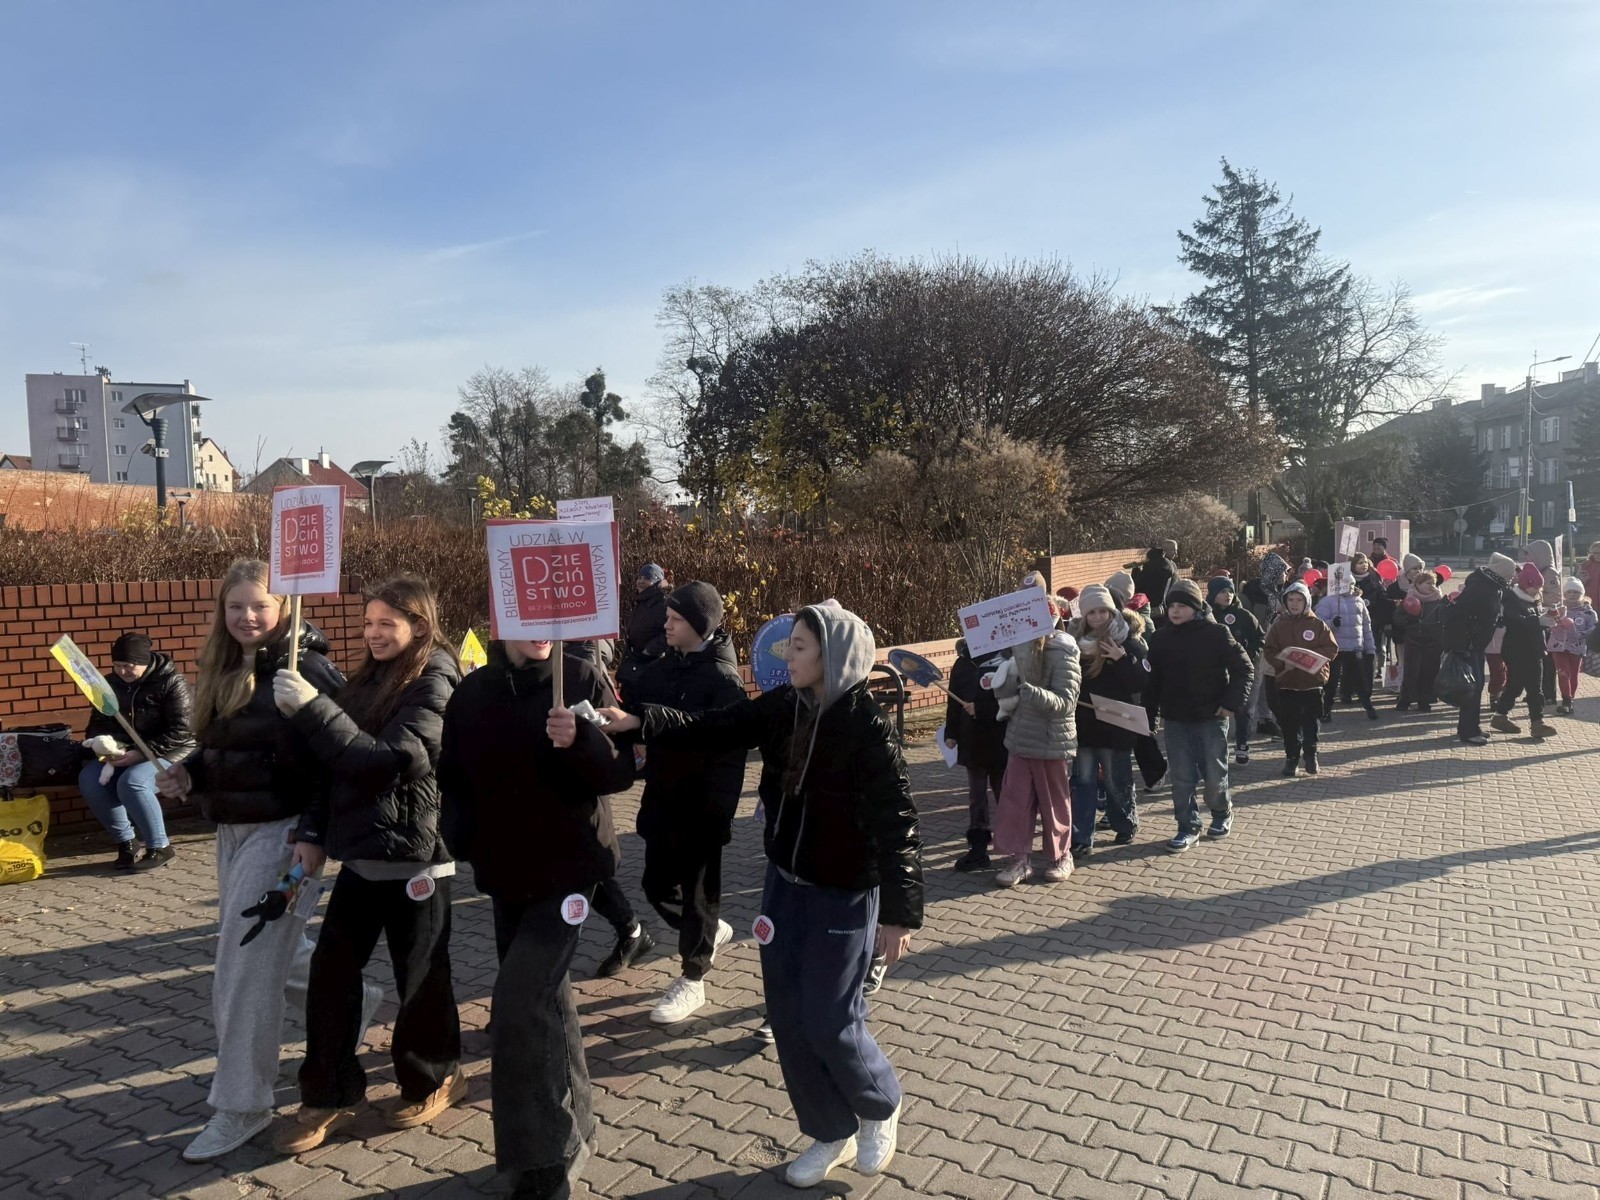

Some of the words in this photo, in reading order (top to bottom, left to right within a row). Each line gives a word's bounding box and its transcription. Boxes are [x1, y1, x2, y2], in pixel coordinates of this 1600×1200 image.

[281, 495, 309, 509] UDZIAŁ
[311, 494, 321, 504] W
[325, 506, 334, 569] KAMPANII
[509, 533, 564, 547] UDZIAŁ
[568, 531, 585, 543] W
[285, 543, 319, 557] STWO
[497, 549, 518, 618] BIERZEMY
[592, 544, 609, 611] KAMPANII
[526, 585, 585, 601] STWO
